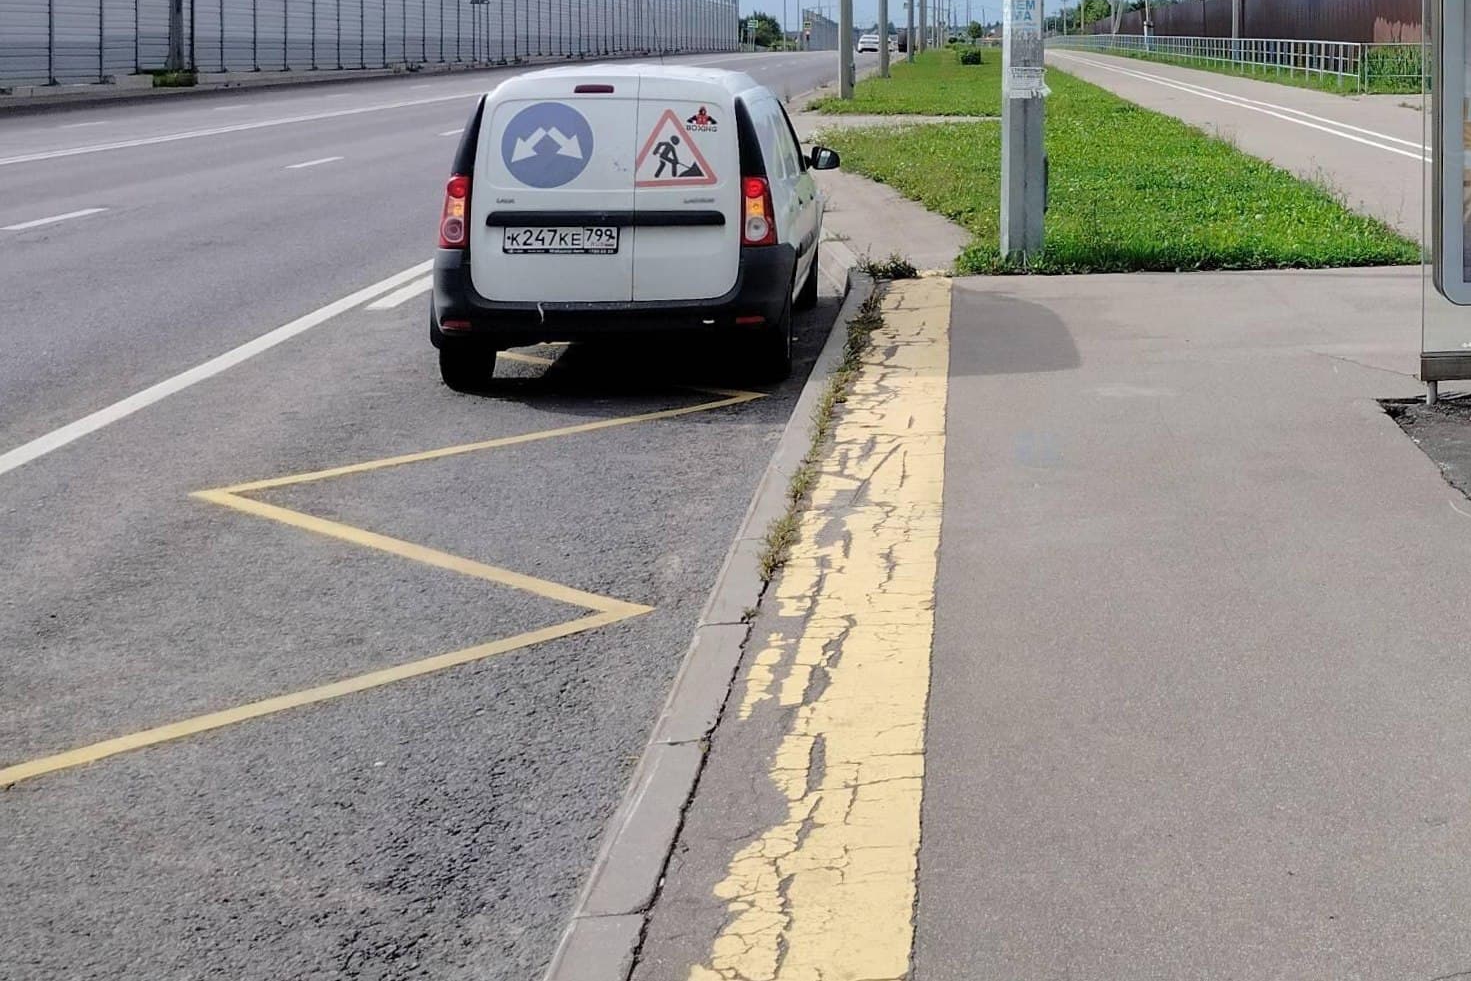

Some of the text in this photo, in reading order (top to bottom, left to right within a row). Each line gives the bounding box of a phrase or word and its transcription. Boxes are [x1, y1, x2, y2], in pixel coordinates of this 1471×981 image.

[686, 124, 718, 133] BOXING
[510, 228, 614, 247] К247КЕ 799
